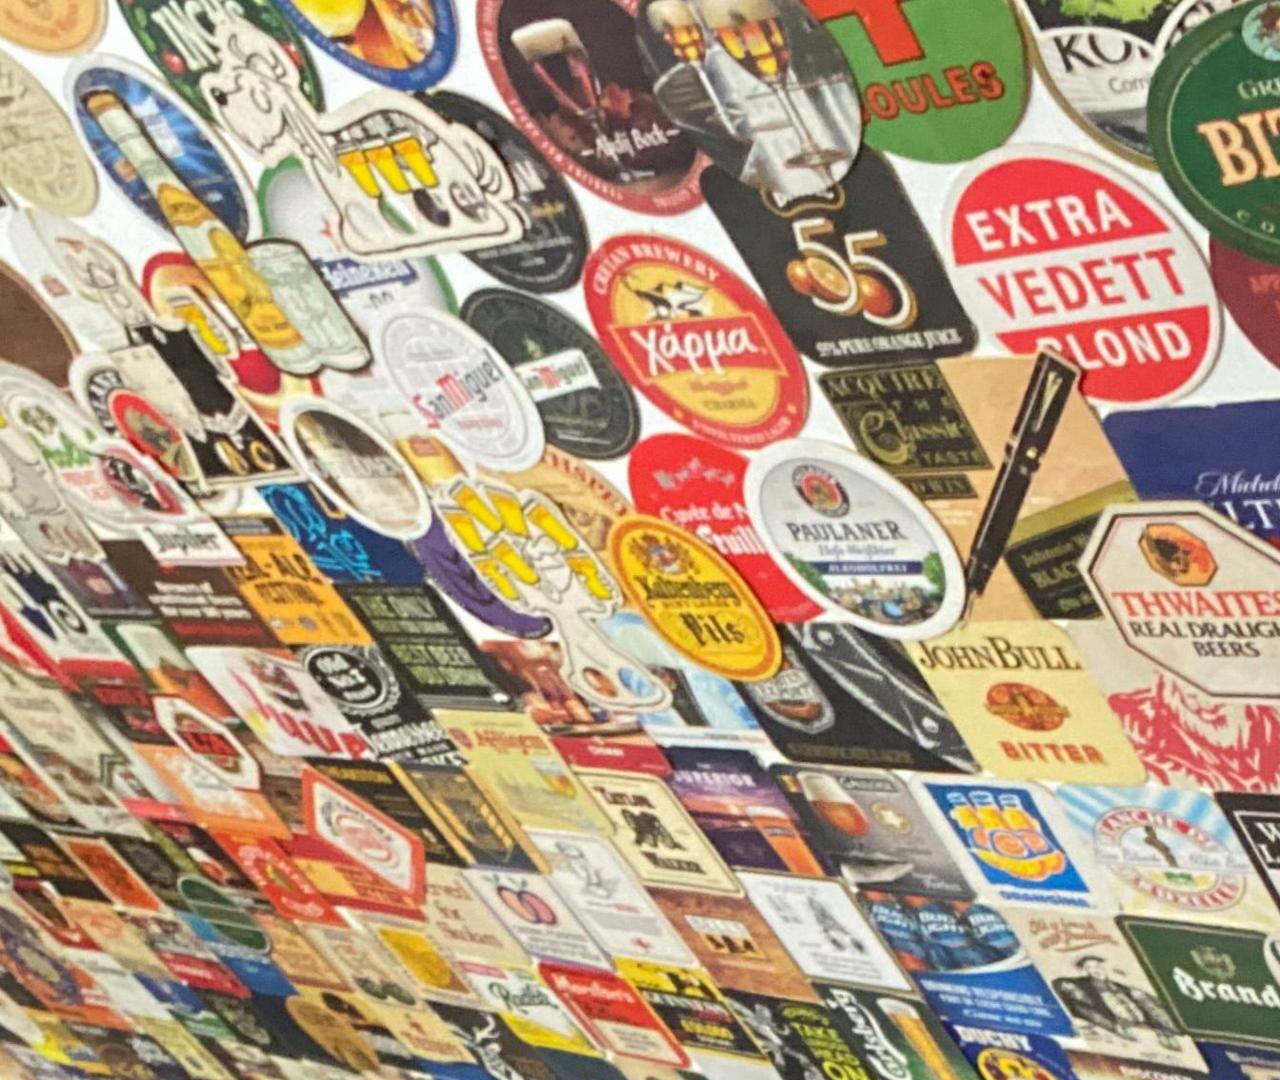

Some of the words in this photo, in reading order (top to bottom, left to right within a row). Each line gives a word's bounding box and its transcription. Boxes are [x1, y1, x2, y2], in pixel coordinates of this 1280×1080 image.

[861, 61, 1007, 125] OULES
[965, 188, 1133, 252] EXTRA
[631, 243, 720, 282] BREWERY
[977, 248, 1187, 321] VEDETT
[786, 520, 910, 543] PAULANER
[680, 612, 746, 646] Pils
[1130, 618, 1183, 642] REAL
[919, 640, 995, 673] JOHN
[995, 635, 1082, 672] BULL
[1193, 638, 1262, 661] BEERS
[999, 739, 1106, 767] BITTER
